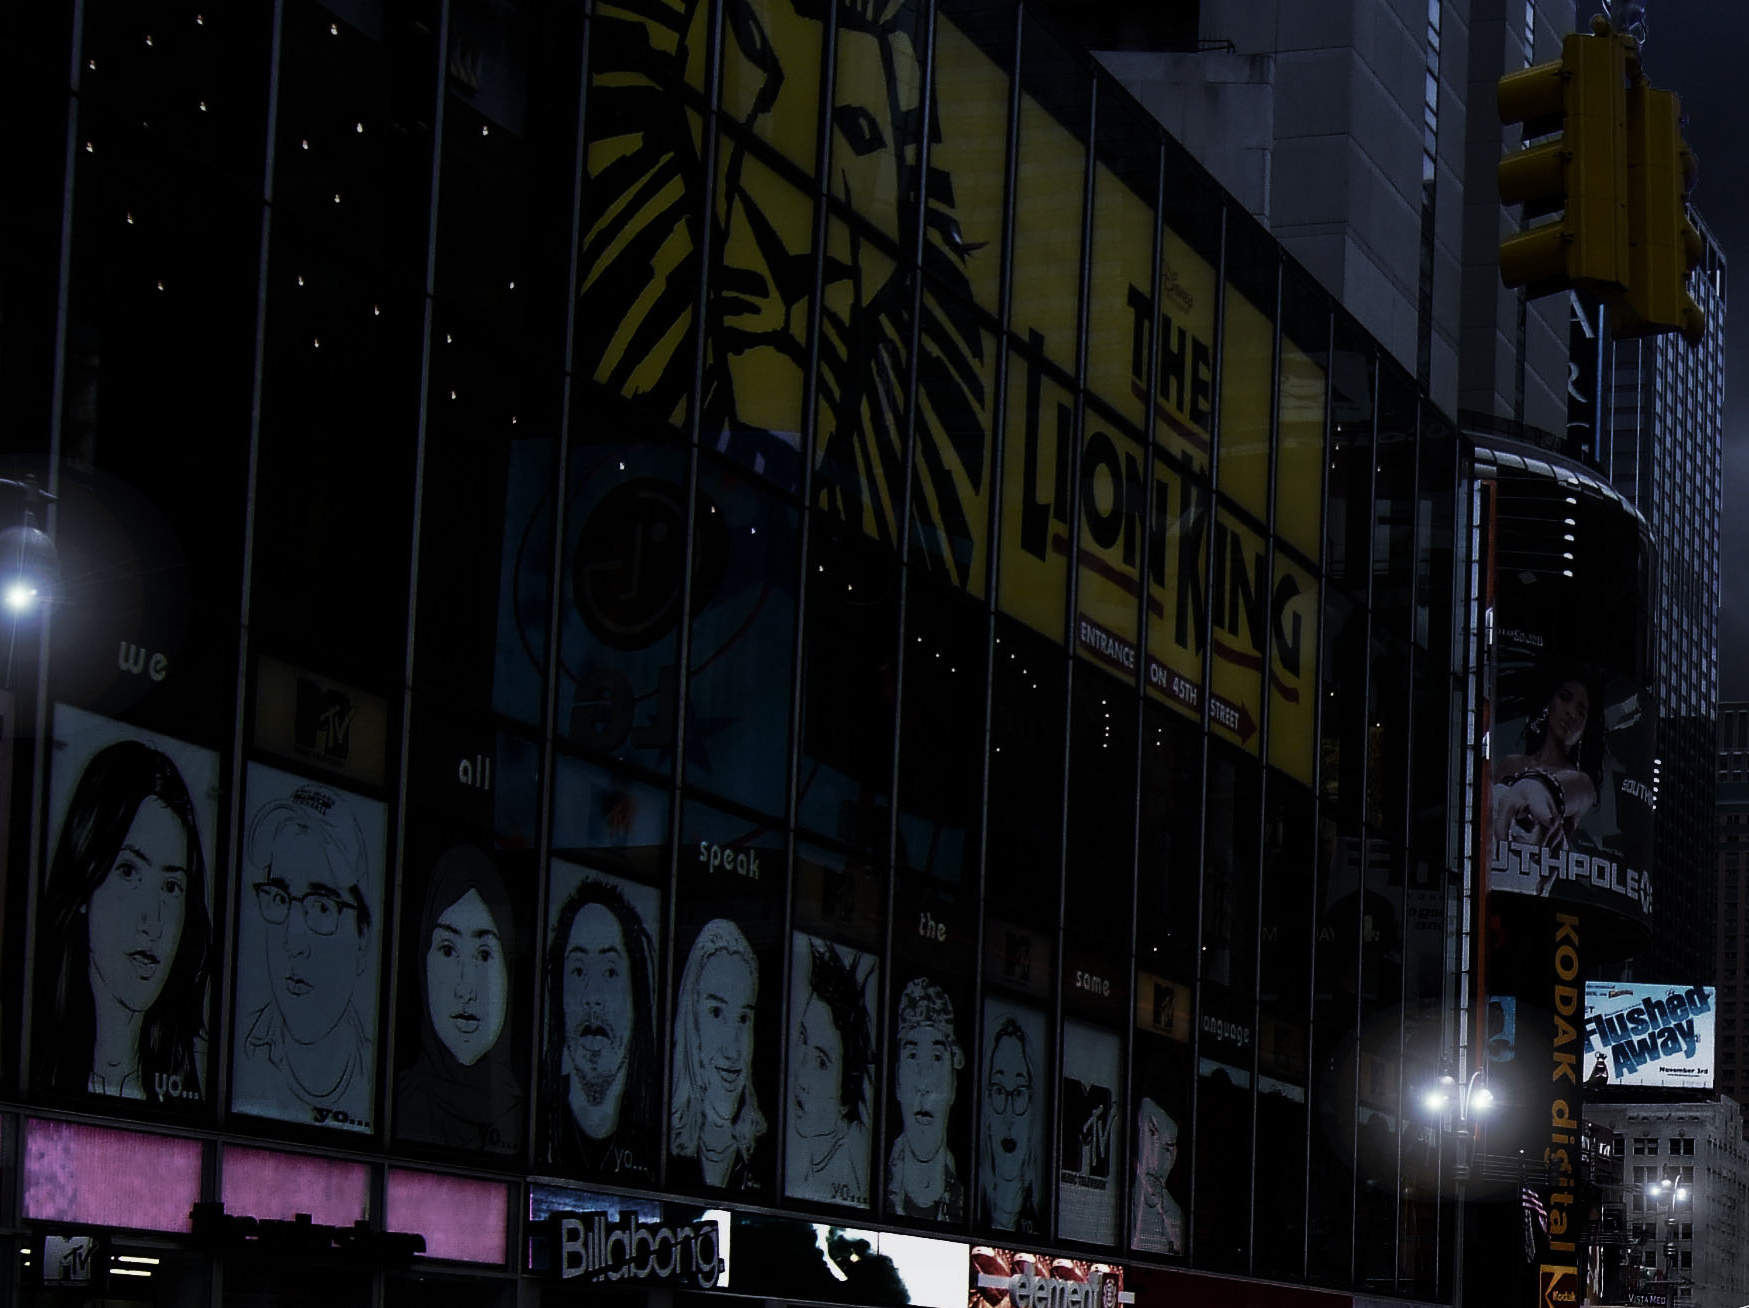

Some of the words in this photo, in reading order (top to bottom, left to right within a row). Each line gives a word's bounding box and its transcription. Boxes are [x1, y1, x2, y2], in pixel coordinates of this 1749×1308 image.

[1127, 283, 1211, 432] THE
[1022, 328, 1168, 590] LION
[1175, 450, 1301, 680] KING
[117, 639, 169, 682] we
[1080, 620, 1136, 670] ENTRANCE
[1150, 661, 1168, 688] ON
[1173, 677, 1198, 706] 45TH
[1209, 697, 1240, 731] STREET
[458, 753, 491, 791] all
[699, 838, 761, 880] speak
[918, 910, 947, 943] the
[1075, 969, 1111, 997] same
[1551, 910, 1580, 1088] KODAK
[1584, 984, 1711, 1054] Flushed
[1611, 1017, 1697, 1079] Away
